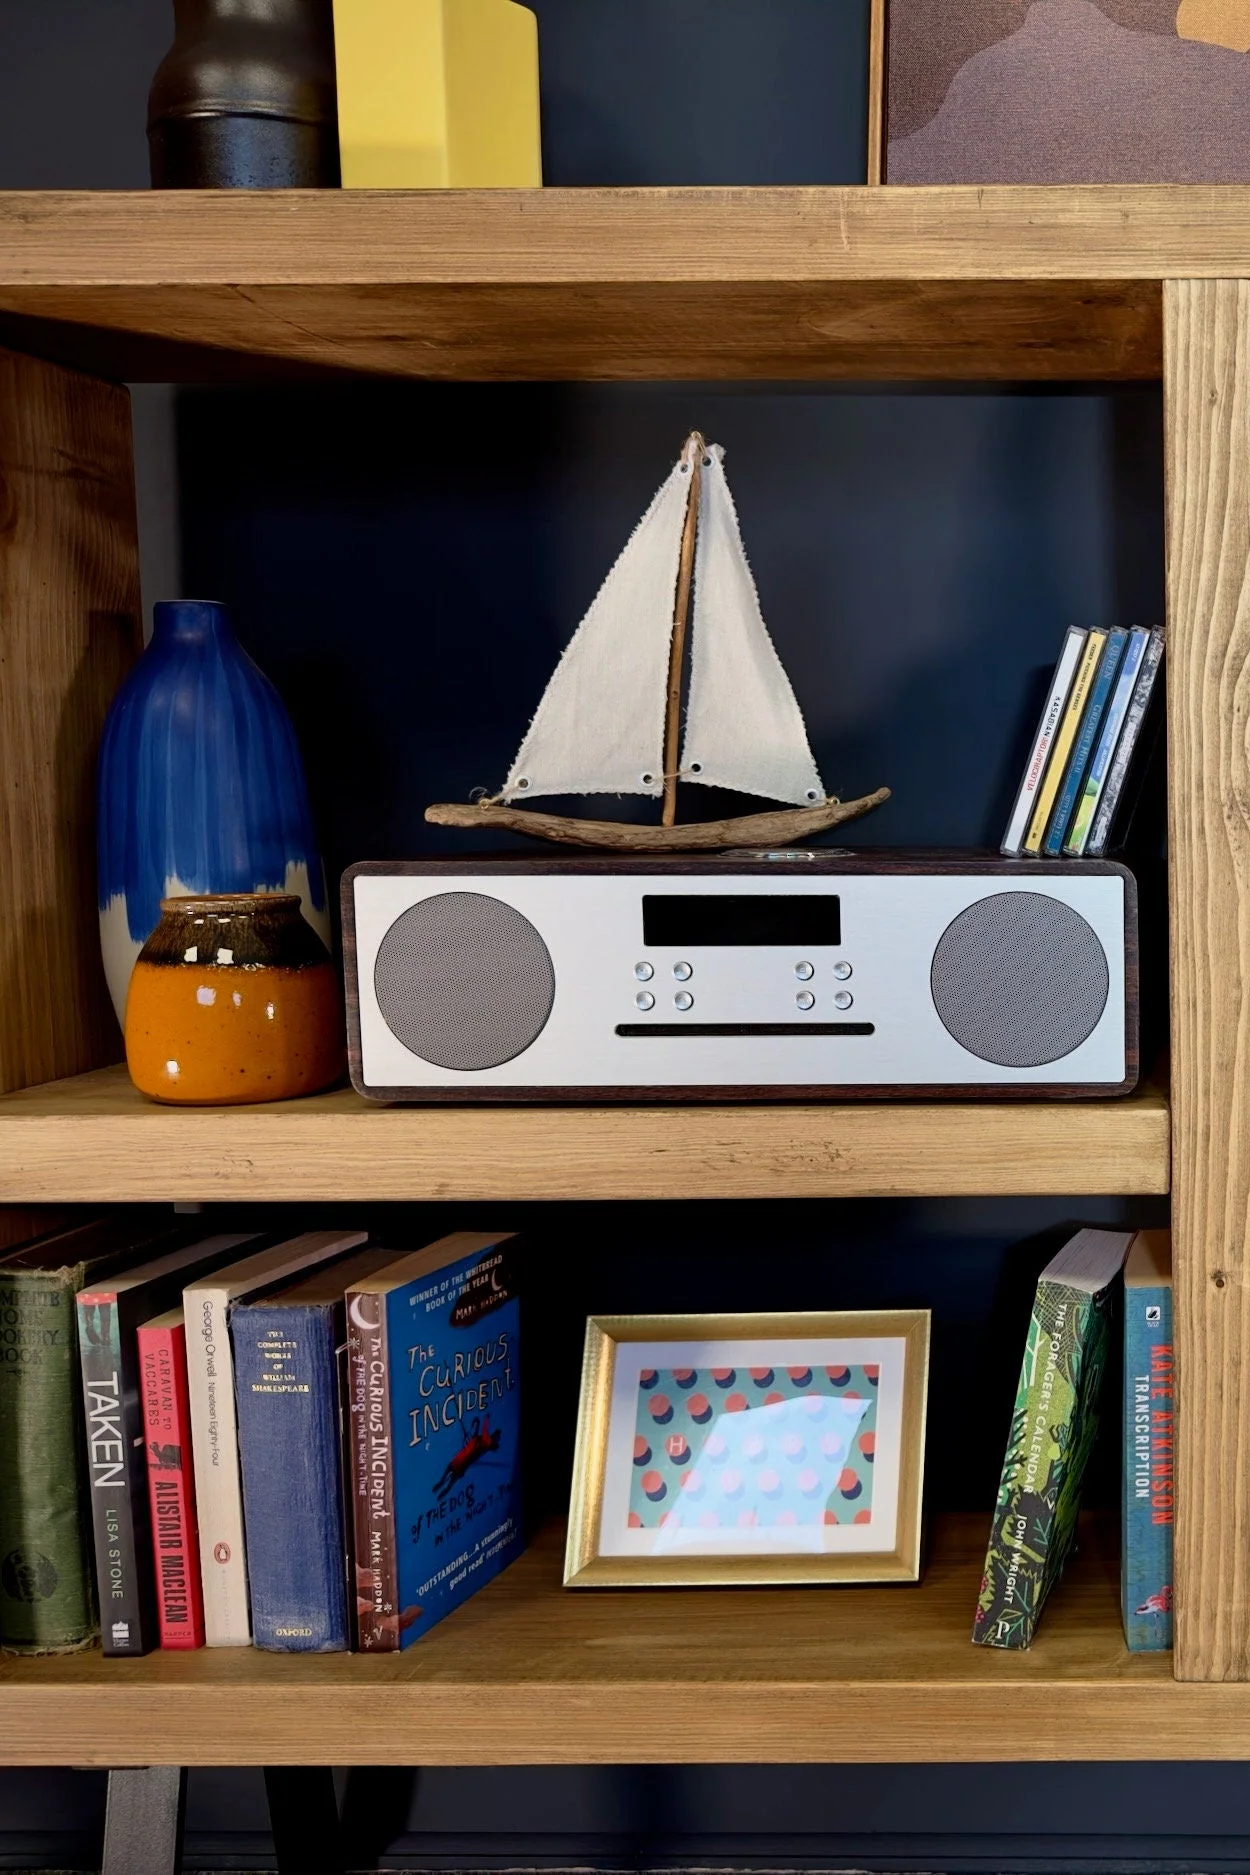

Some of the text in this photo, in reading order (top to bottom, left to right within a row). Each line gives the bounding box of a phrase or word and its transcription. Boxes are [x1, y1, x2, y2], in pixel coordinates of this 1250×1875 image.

[1081, 643, 1120, 744] QUEEN GREATEST
[409, 1255, 503, 1307] WINNER OF THE WHITBREAD
[425, 1273, 489, 1313] BOOK OF THE YEAR
[144, 1353, 161, 1427] VACCARES
[157, 1348, 174, 1431] CARAVAN TO
[200, 1301, 222, 1467] George Orwell Nineteen Eighty-Four
[252, 1384, 310, 1393] SHAKESPEARE
[1022, 1302, 1068, 1495] THE FORAGER'S CALENDAR
[1151, 1344, 1173, 1399] KATE
[1135, 1374, 1150, 1499] TRANSCRIPTION
[1151, 1410, 1173, 1526] ATKINSON
[87, 1370, 126, 1599] TAKEN LISA STONE
[153, 1481, 189, 1624] ALISTAIR MACLEAN
[370, 1531, 384, 1613] MARK HADDON
[449, 1569, 467, 1591] good
[1003, 1513, 1028, 1605] JOHN WRIGHT
[276, 1628, 313, 1637] OXFORD
